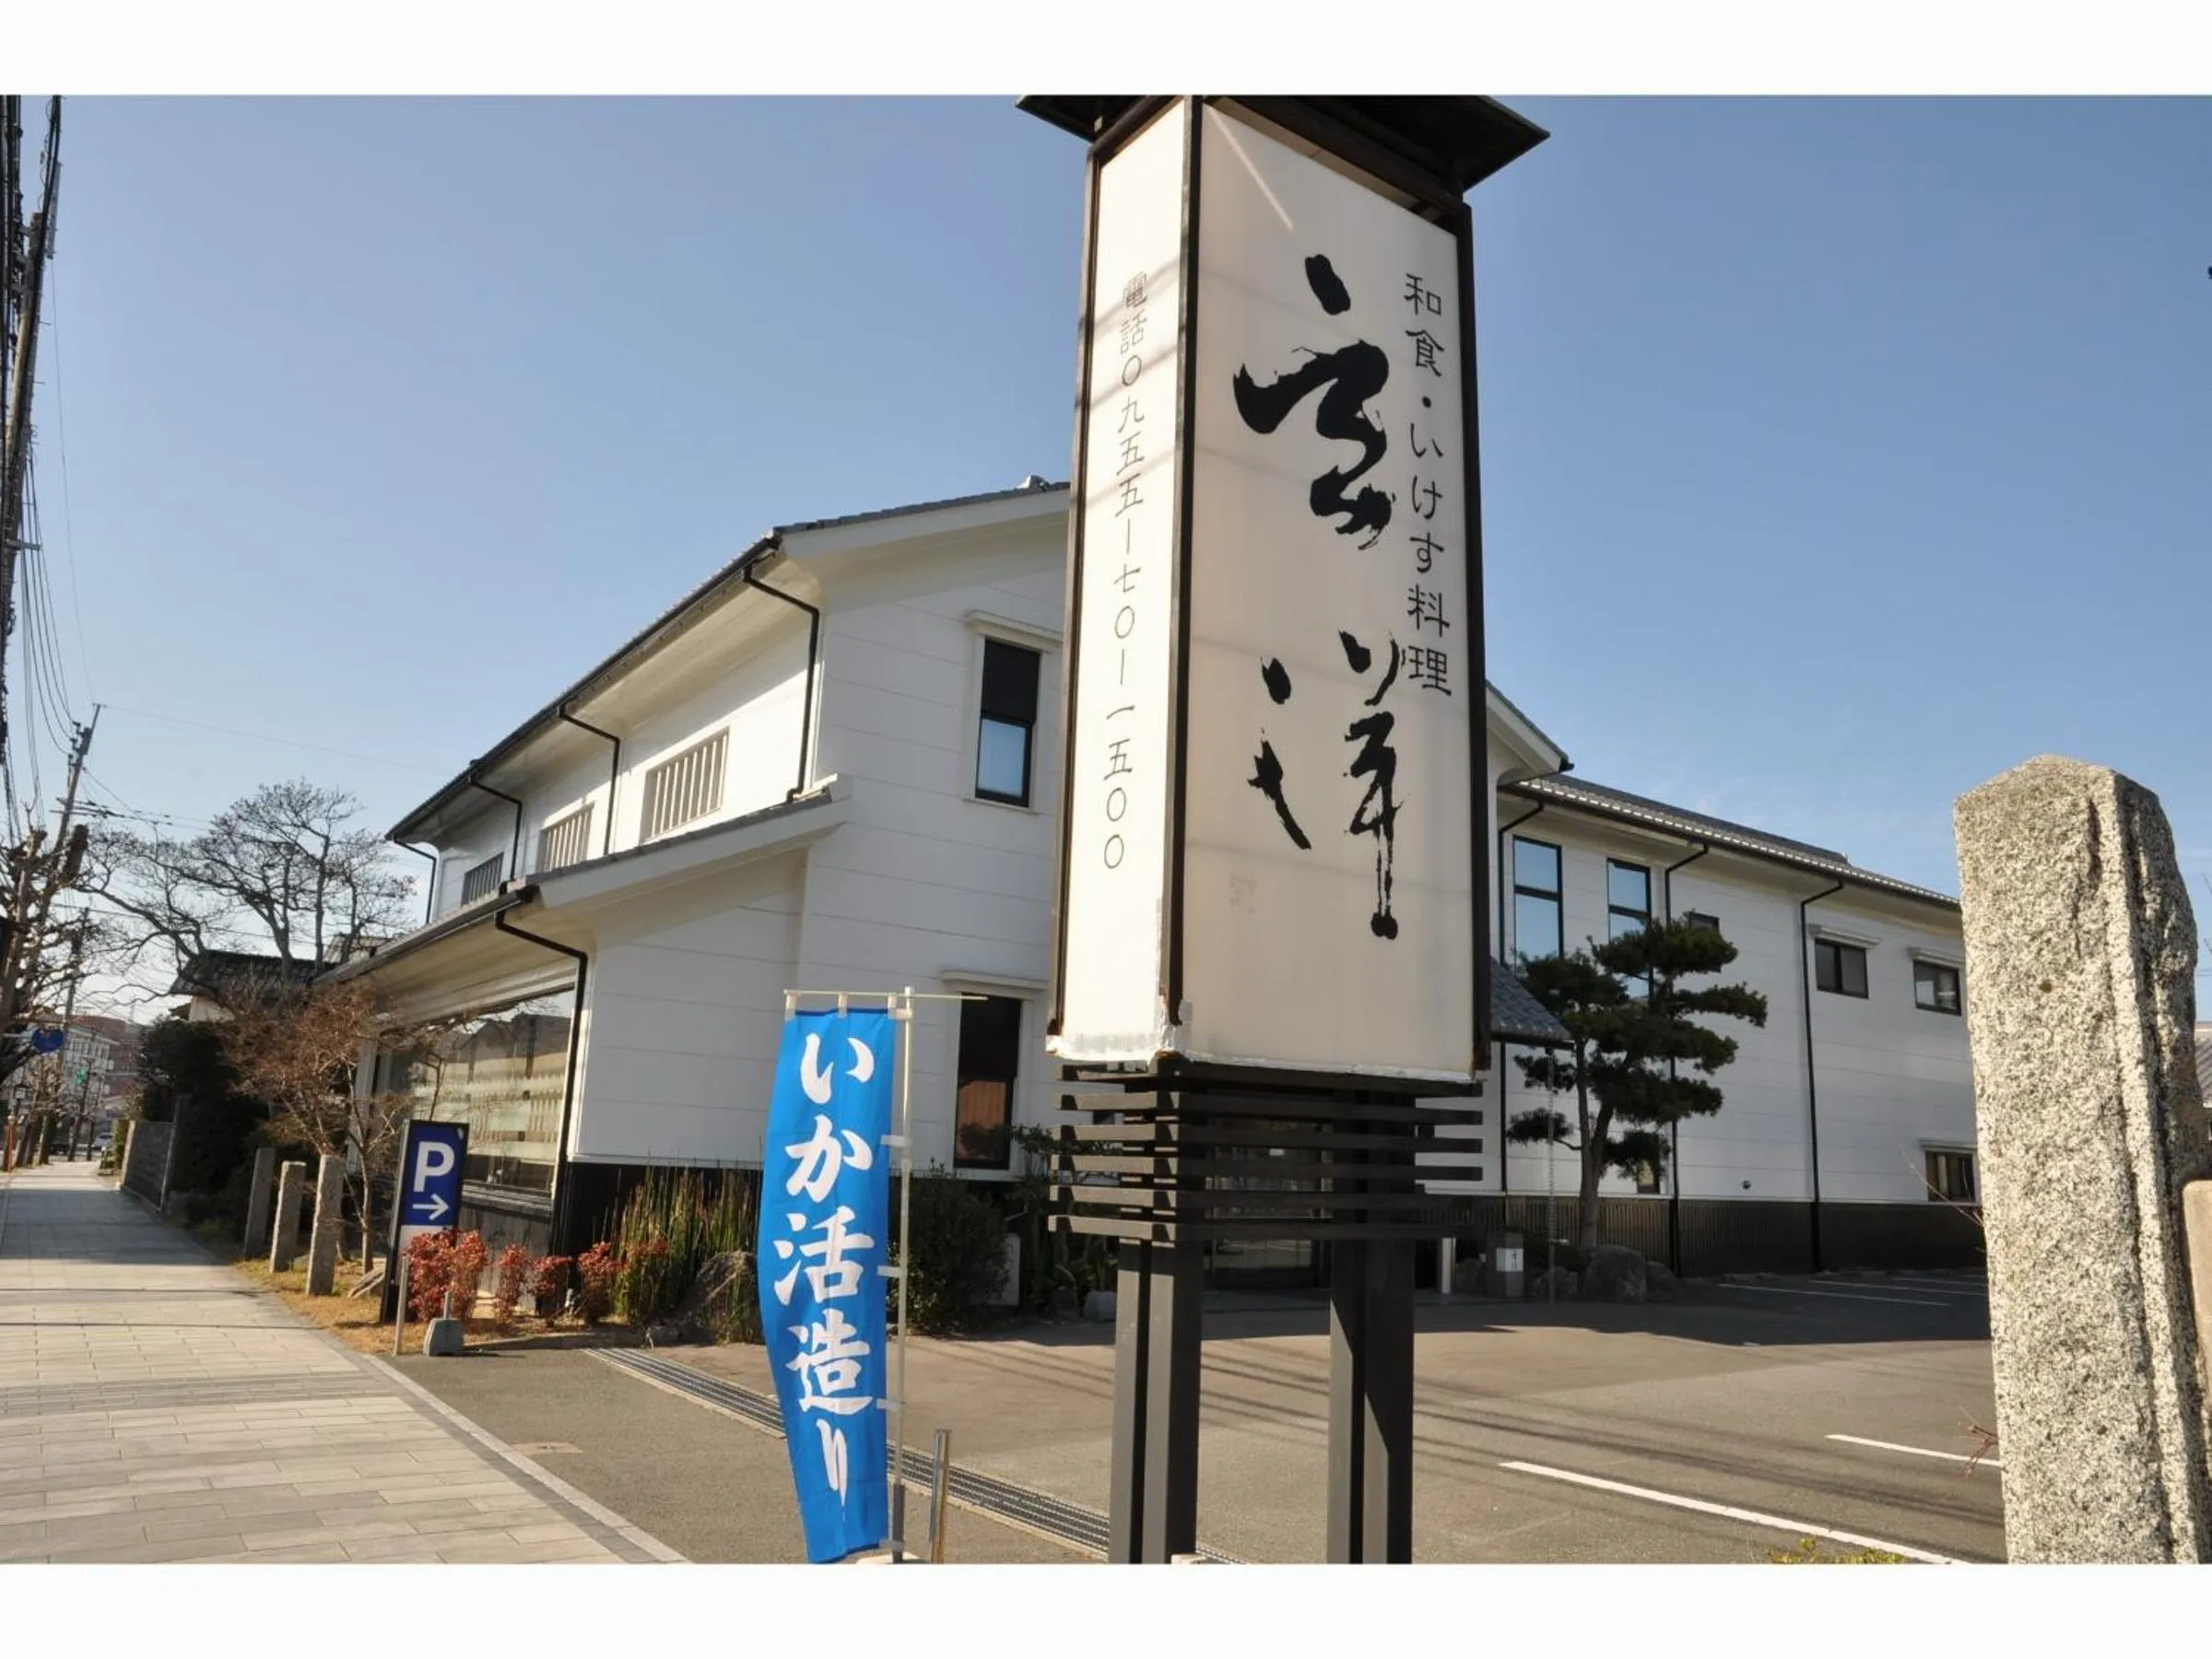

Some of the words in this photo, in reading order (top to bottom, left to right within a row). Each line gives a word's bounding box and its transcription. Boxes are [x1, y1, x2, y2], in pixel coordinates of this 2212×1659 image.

[1404, 273, 1453, 696] 和食・いけす料理
[413, 1141, 455, 1193] P
[774, 1032, 875, 1513] いか活造り
